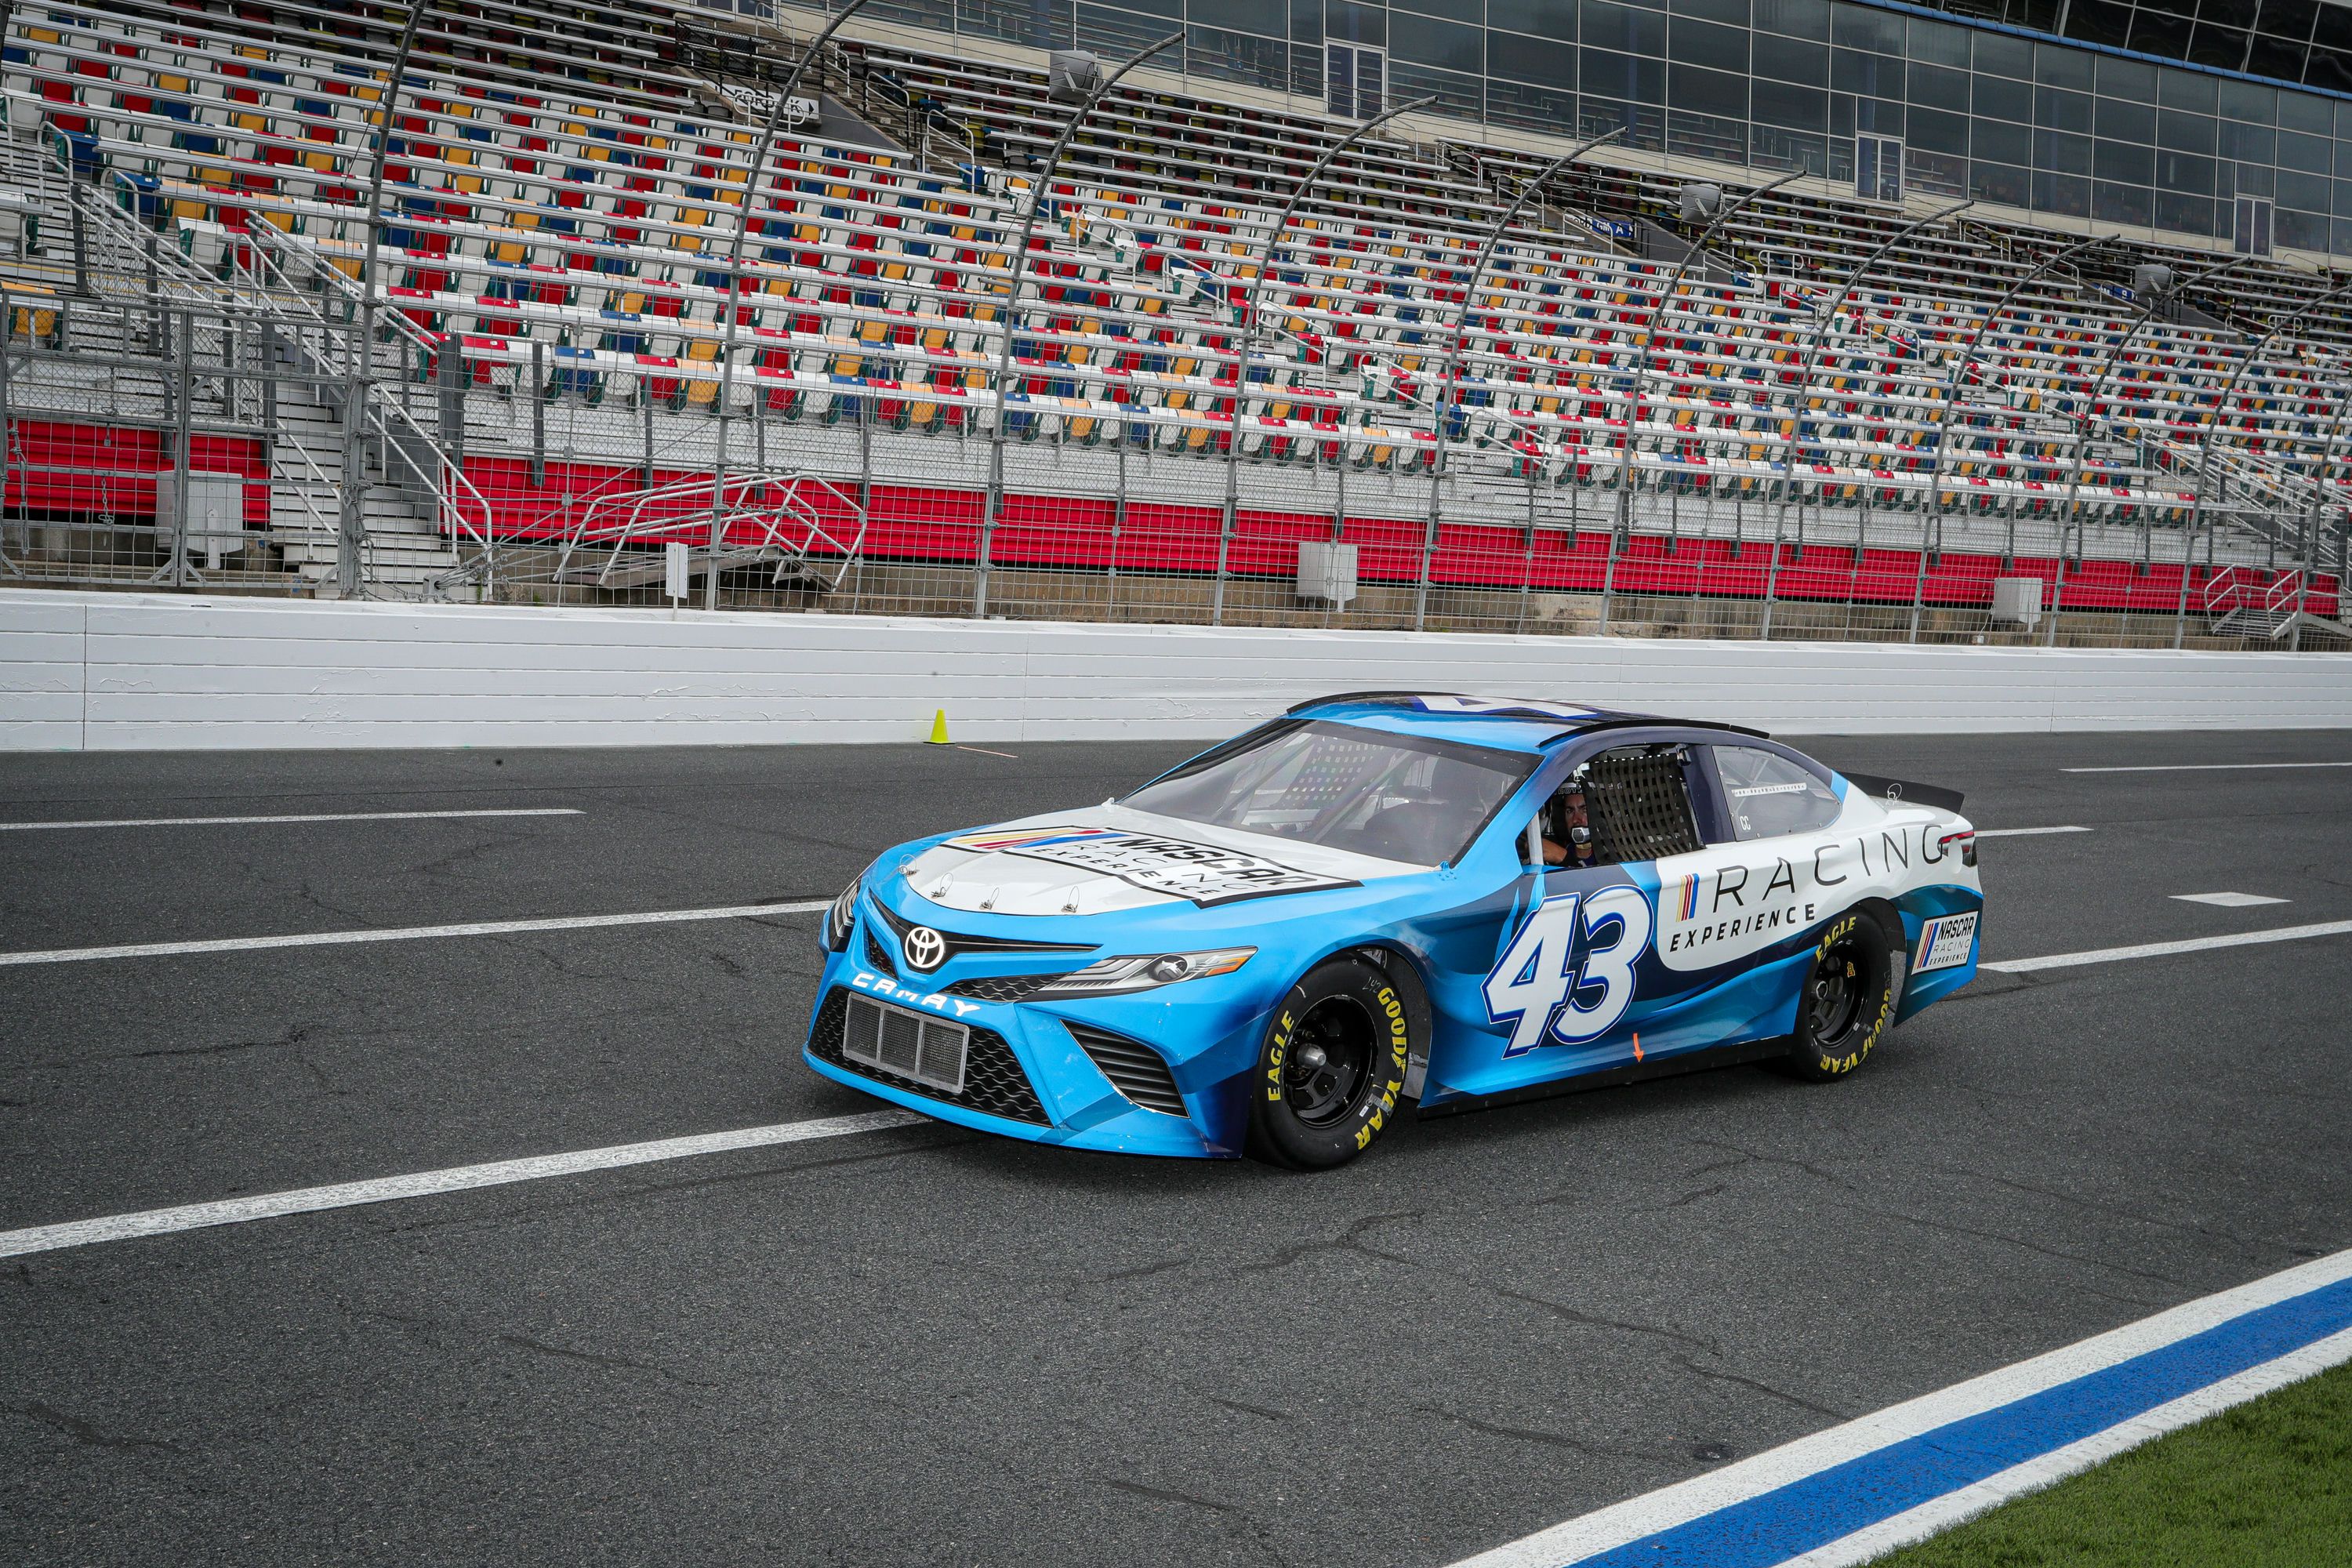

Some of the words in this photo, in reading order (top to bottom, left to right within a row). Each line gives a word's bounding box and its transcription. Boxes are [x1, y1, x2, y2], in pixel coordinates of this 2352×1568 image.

[1740, 815, 1751, 830] CC
[1033, 848, 1221, 895] EXPERIENCE
[1065, 844, 1259, 890] RACNG
[1100, 837, 1318, 886] NASCAR
[1712, 824, 1944, 914] RACING
[1669, 902, 1816, 953] EXPERIENCE
[1814, 916, 1857, 963] EAGLE
[1933, 938, 1971, 954] RACING
[1937, 916, 1975, 942] NASCAR
[1480, 884, 1654, 1061] 43
[1929, 952, 1968, 966] EXPERIENCE
[1267, 1009, 1294, 1102] EAGLE
